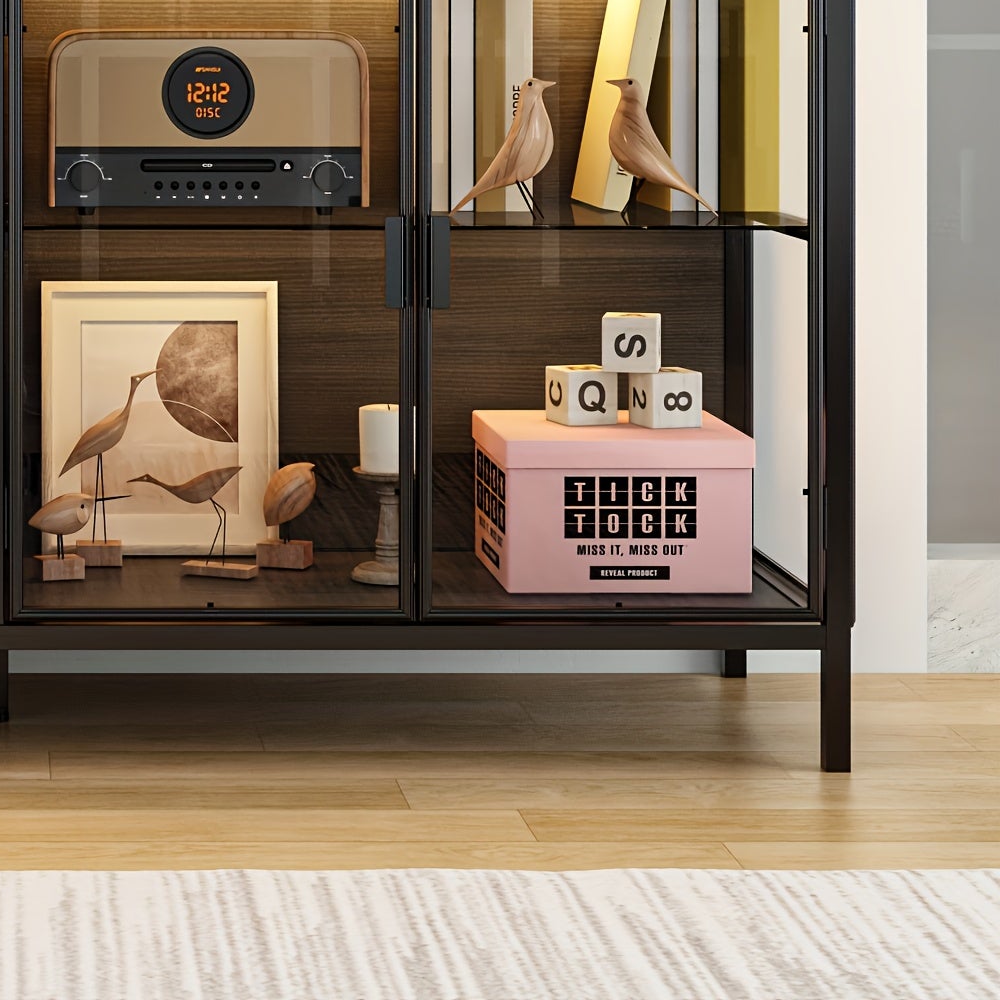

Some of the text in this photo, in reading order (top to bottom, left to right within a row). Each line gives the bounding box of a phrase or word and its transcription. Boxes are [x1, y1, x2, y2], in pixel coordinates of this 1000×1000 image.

[187, 82, 230, 103] 12:12
[614, 332, 647, 359] S
[578, 380, 607, 414] Q
[632, 386, 647, 410] 2
[663, 391, 693, 412] 8
[573, 482, 688, 502] TICK
[573, 513, 688, 534] TOCK
[577, 544, 685, 557] MISS IT, MISS OUT
[600, 569, 658, 577] REVEAL PRODUCT
